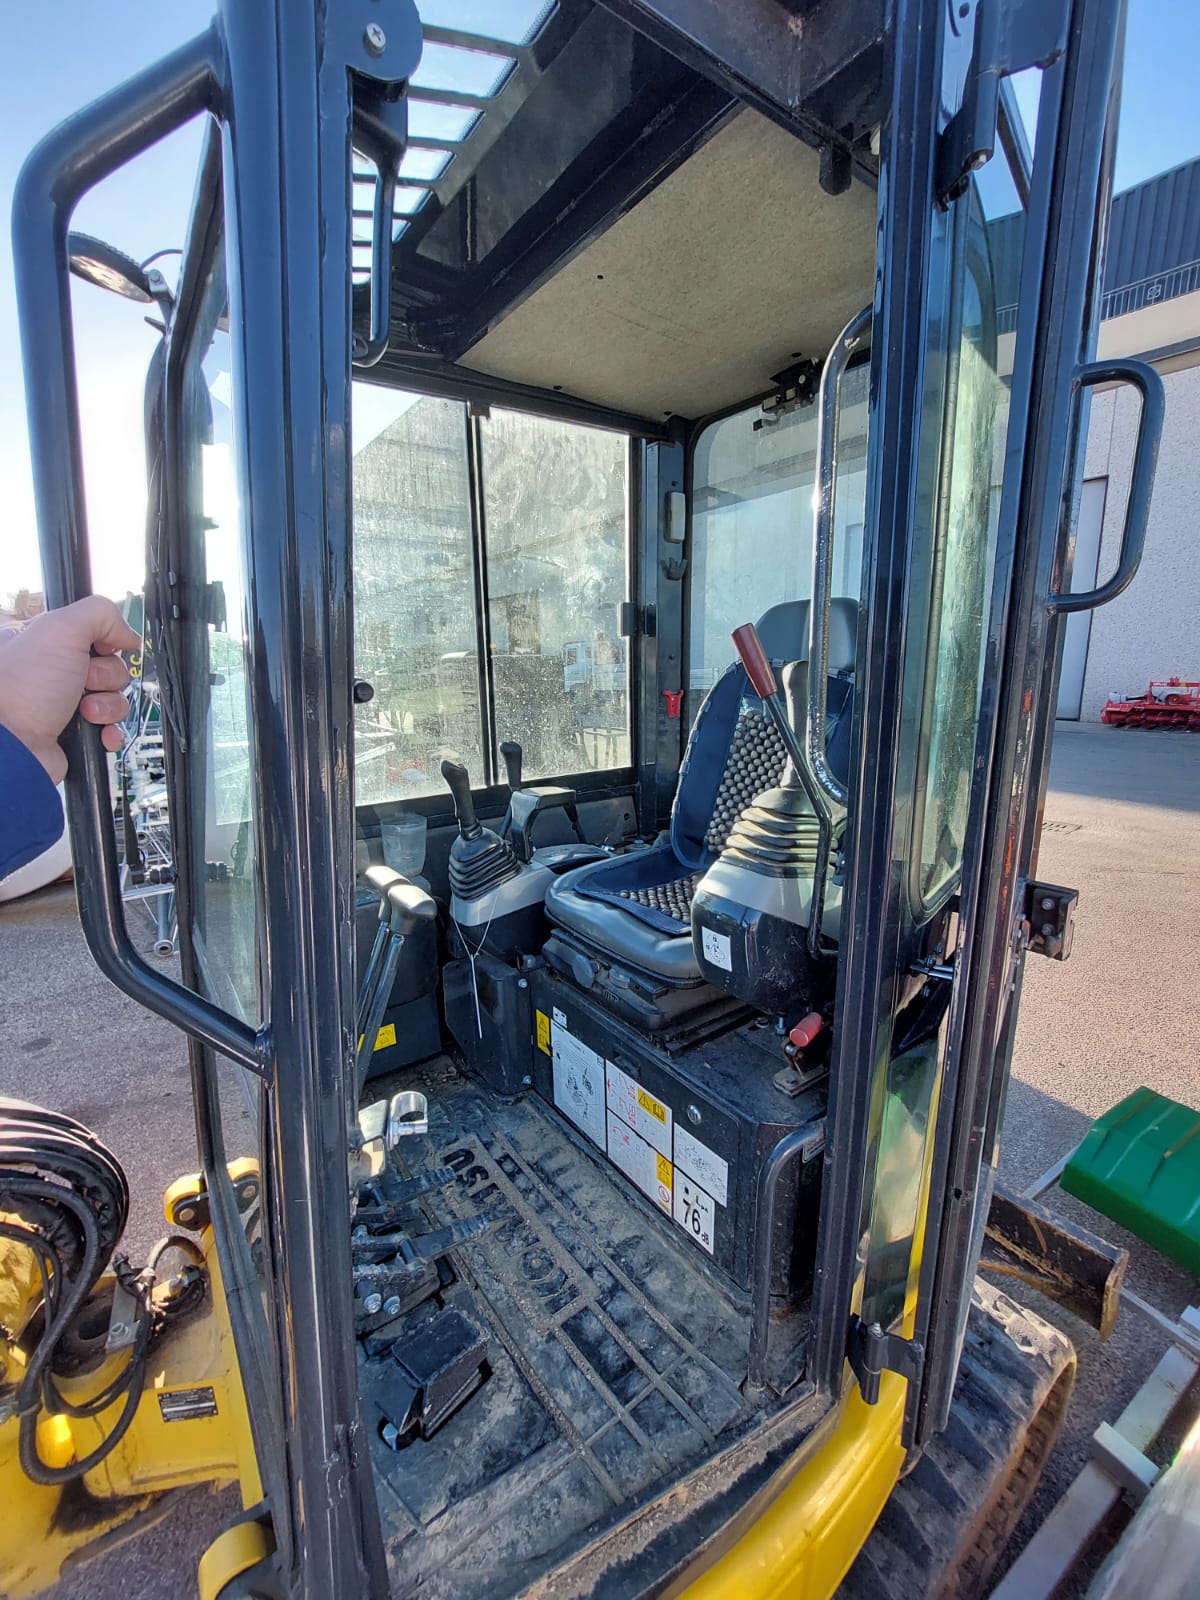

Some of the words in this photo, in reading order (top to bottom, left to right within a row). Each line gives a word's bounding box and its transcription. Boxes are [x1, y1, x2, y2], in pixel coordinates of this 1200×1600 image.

[443, 1148, 580, 1315] KOMATSU
[683, 1199, 701, 1235] 76
[701, 1232, 709, 1245] dB
